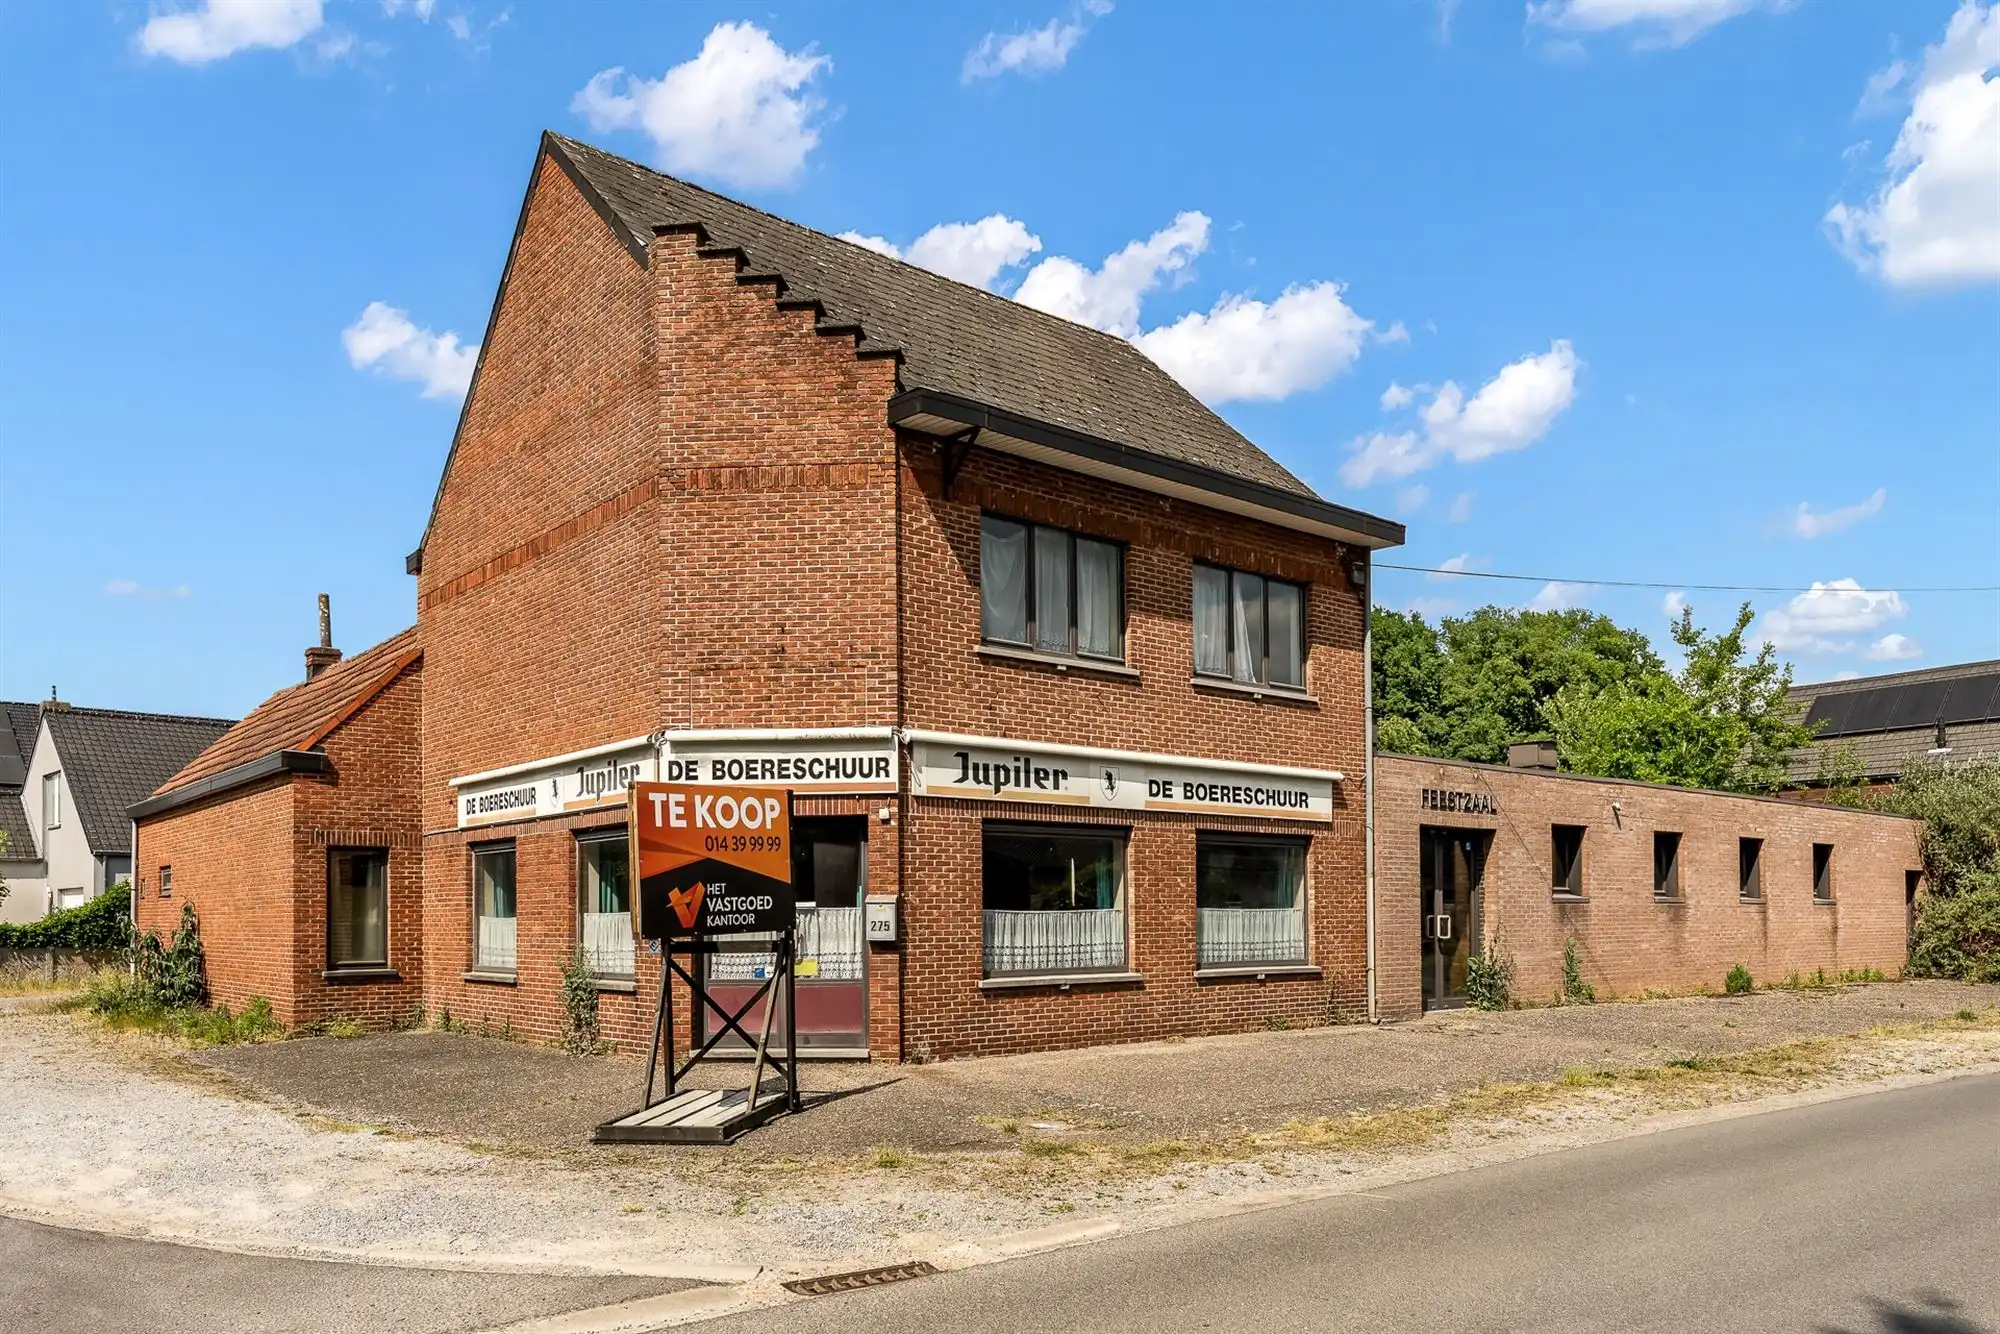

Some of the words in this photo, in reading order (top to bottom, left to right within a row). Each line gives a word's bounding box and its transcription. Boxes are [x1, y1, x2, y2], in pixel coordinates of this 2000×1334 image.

[575, 759, 641, 802] Jupiler
[668, 759, 699, 781] DE
[712, 757, 890, 781] BOERESCHUUR
[952, 751, 1069, 796] Jupiler
[466, 798, 476, 815] DE
[479, 786, 537, 814] BOERESCHUUR
[1148, 779, 1173, 799] DE
[1183, 782, 1309, 809] BOERESCHUUR
[1421, 788, 1497, 815] FEESTZAAL
[648, 792, 688, 828] TE
[694, 794, 781, 830] KOOP
[705, 835, 728, 852] 014
[731, 836, 747, 852] 39
[749, 836, 764, 852] 99
[766, 836, 782, 852] 99
[706, 883, 726, 895] HET
[706, 896, 773, 912] VASTGOED
[706, 913, 756, 927] KANTOOR
[870, 920, 890, 932] 275
